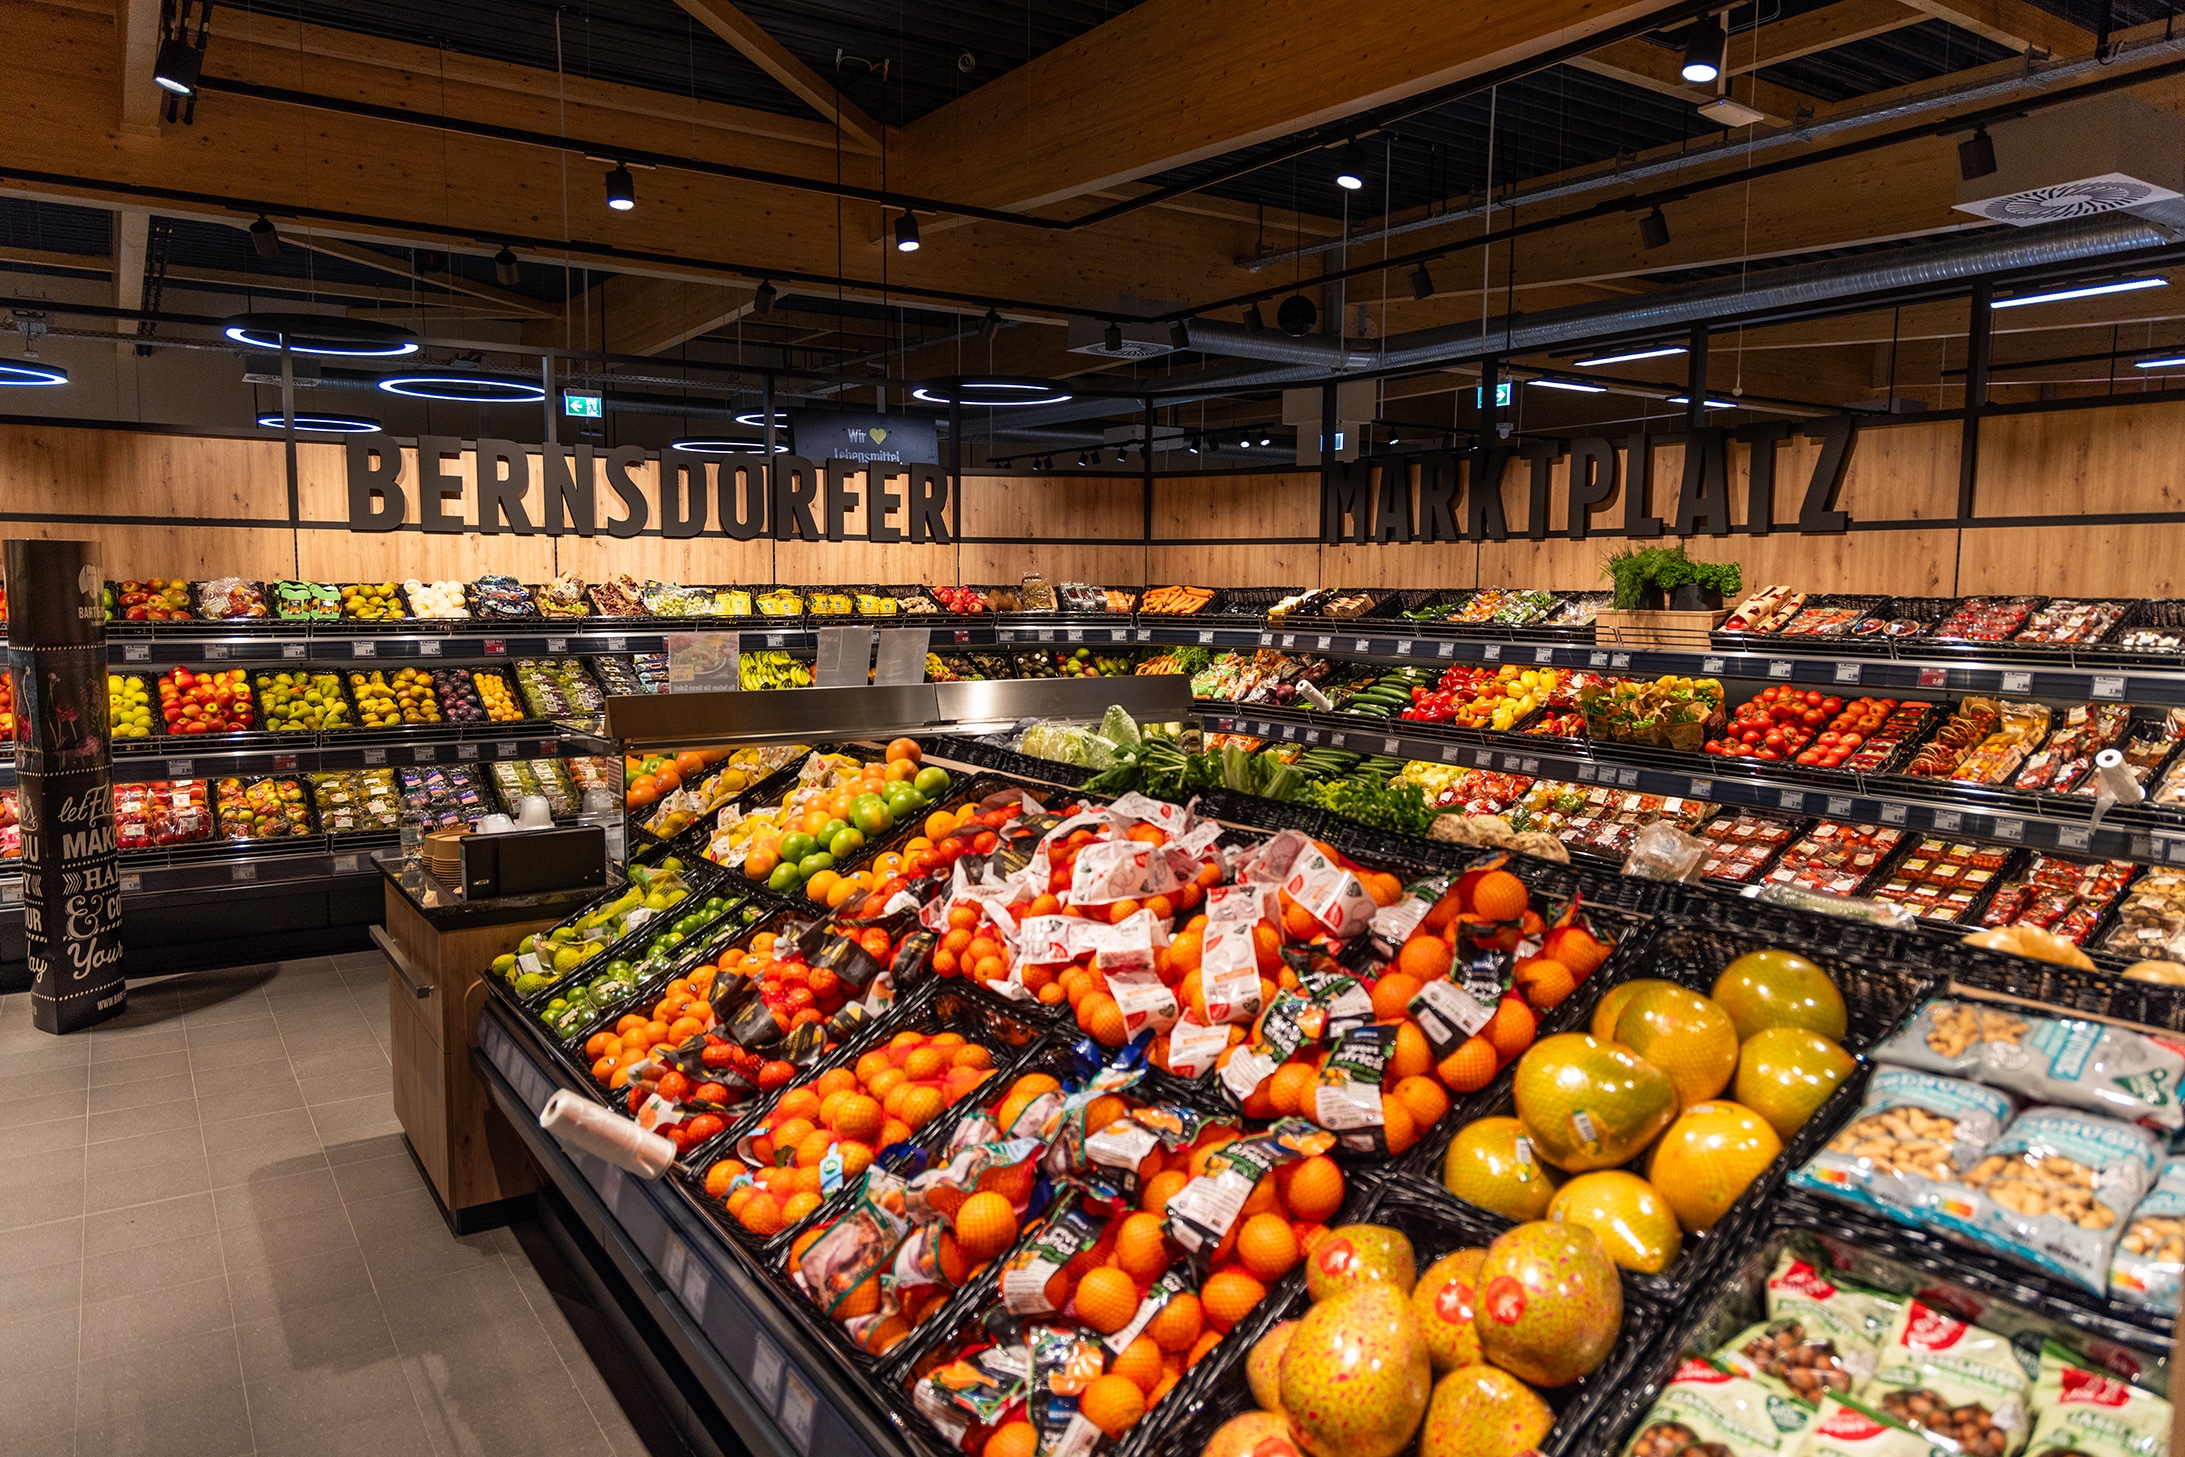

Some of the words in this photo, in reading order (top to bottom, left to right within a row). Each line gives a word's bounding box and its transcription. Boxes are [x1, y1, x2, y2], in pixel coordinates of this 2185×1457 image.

[848, 428, 867, 443] Wir
[346, 433, 952, 545] BERNSDORFER
[1323, 414, 1856, 543] MARKTPLATZ
[58, 796, 88, 823] let
